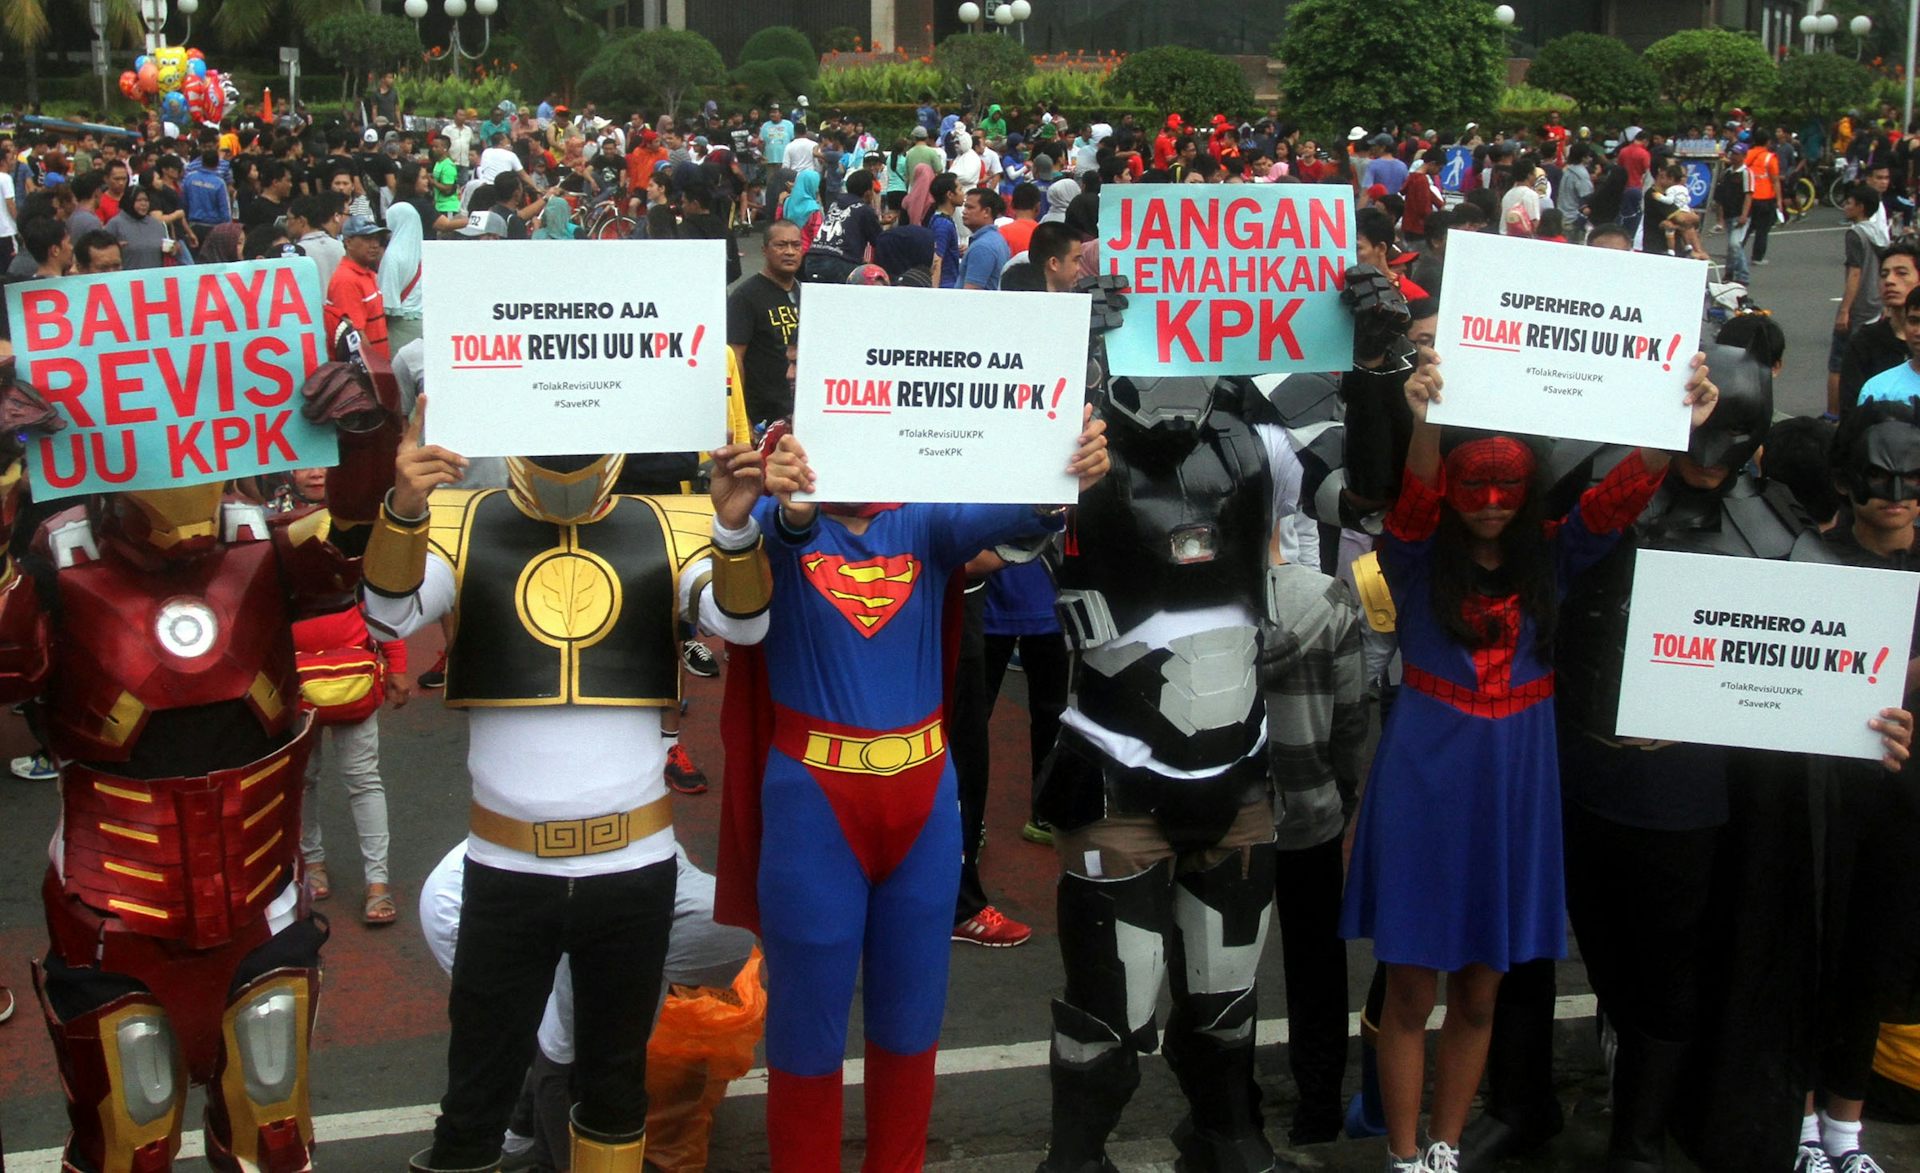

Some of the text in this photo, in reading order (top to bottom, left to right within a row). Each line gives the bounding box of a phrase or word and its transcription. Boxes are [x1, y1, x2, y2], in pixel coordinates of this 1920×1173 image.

[1106, 197, 1347, 251] JANGAN
[1109, 255, 1346, 294] LEMAHKAN
[21, 267, 312, 352] BAHAYA
[492, 302, 659, 320] SUPERHERO AJA
[1500, 291, 1643, 324] SUPERHERO AJA
[1155, 298, 1305, 364] KPK
[1461, 315, 1523, 346] TOLAK
[1526, 323, 1588, 353] REVISI
[1591, 331, 1619, 357] UU
[451, 334, 523, 362] TOLAK
[527, 333, 598, 360] REVISI
[603, 333, 634, 359] UU
[866, 348, 1024, 370] SUPERHERO AJA
[532, 381, 622, 391] #TolakRevisiUUKPK
[1526, 367, 1604, 383] #TolakRevisiUUKPK
[554, 399, 600, 409] #SaveKPK
[823, 378, 893, 407] TOLAK
[897, 381, 964, 408] REVISI
[969, 384, 998, 409] UU
[1543, 385, 1583, 397] #SaveKPK
[899, 429, 984, 439] #TolakRevisiUUKPK
[39, 409, 299, 489] UU KPK
[918, 447, 963, 457] #SaveKPK
[1693, 609, 1847, 637] SUPERHERO AJA
[1653, 633, 1718, 661] TOLAK
[1720, 639, 1787, 668] REVISI
[1791, 646, 1820, 670] UU
[1720, 681, 1804, 696] #TolakRevisiUUKPK
[1738, 699, 1782, 710] #SaveKPK
